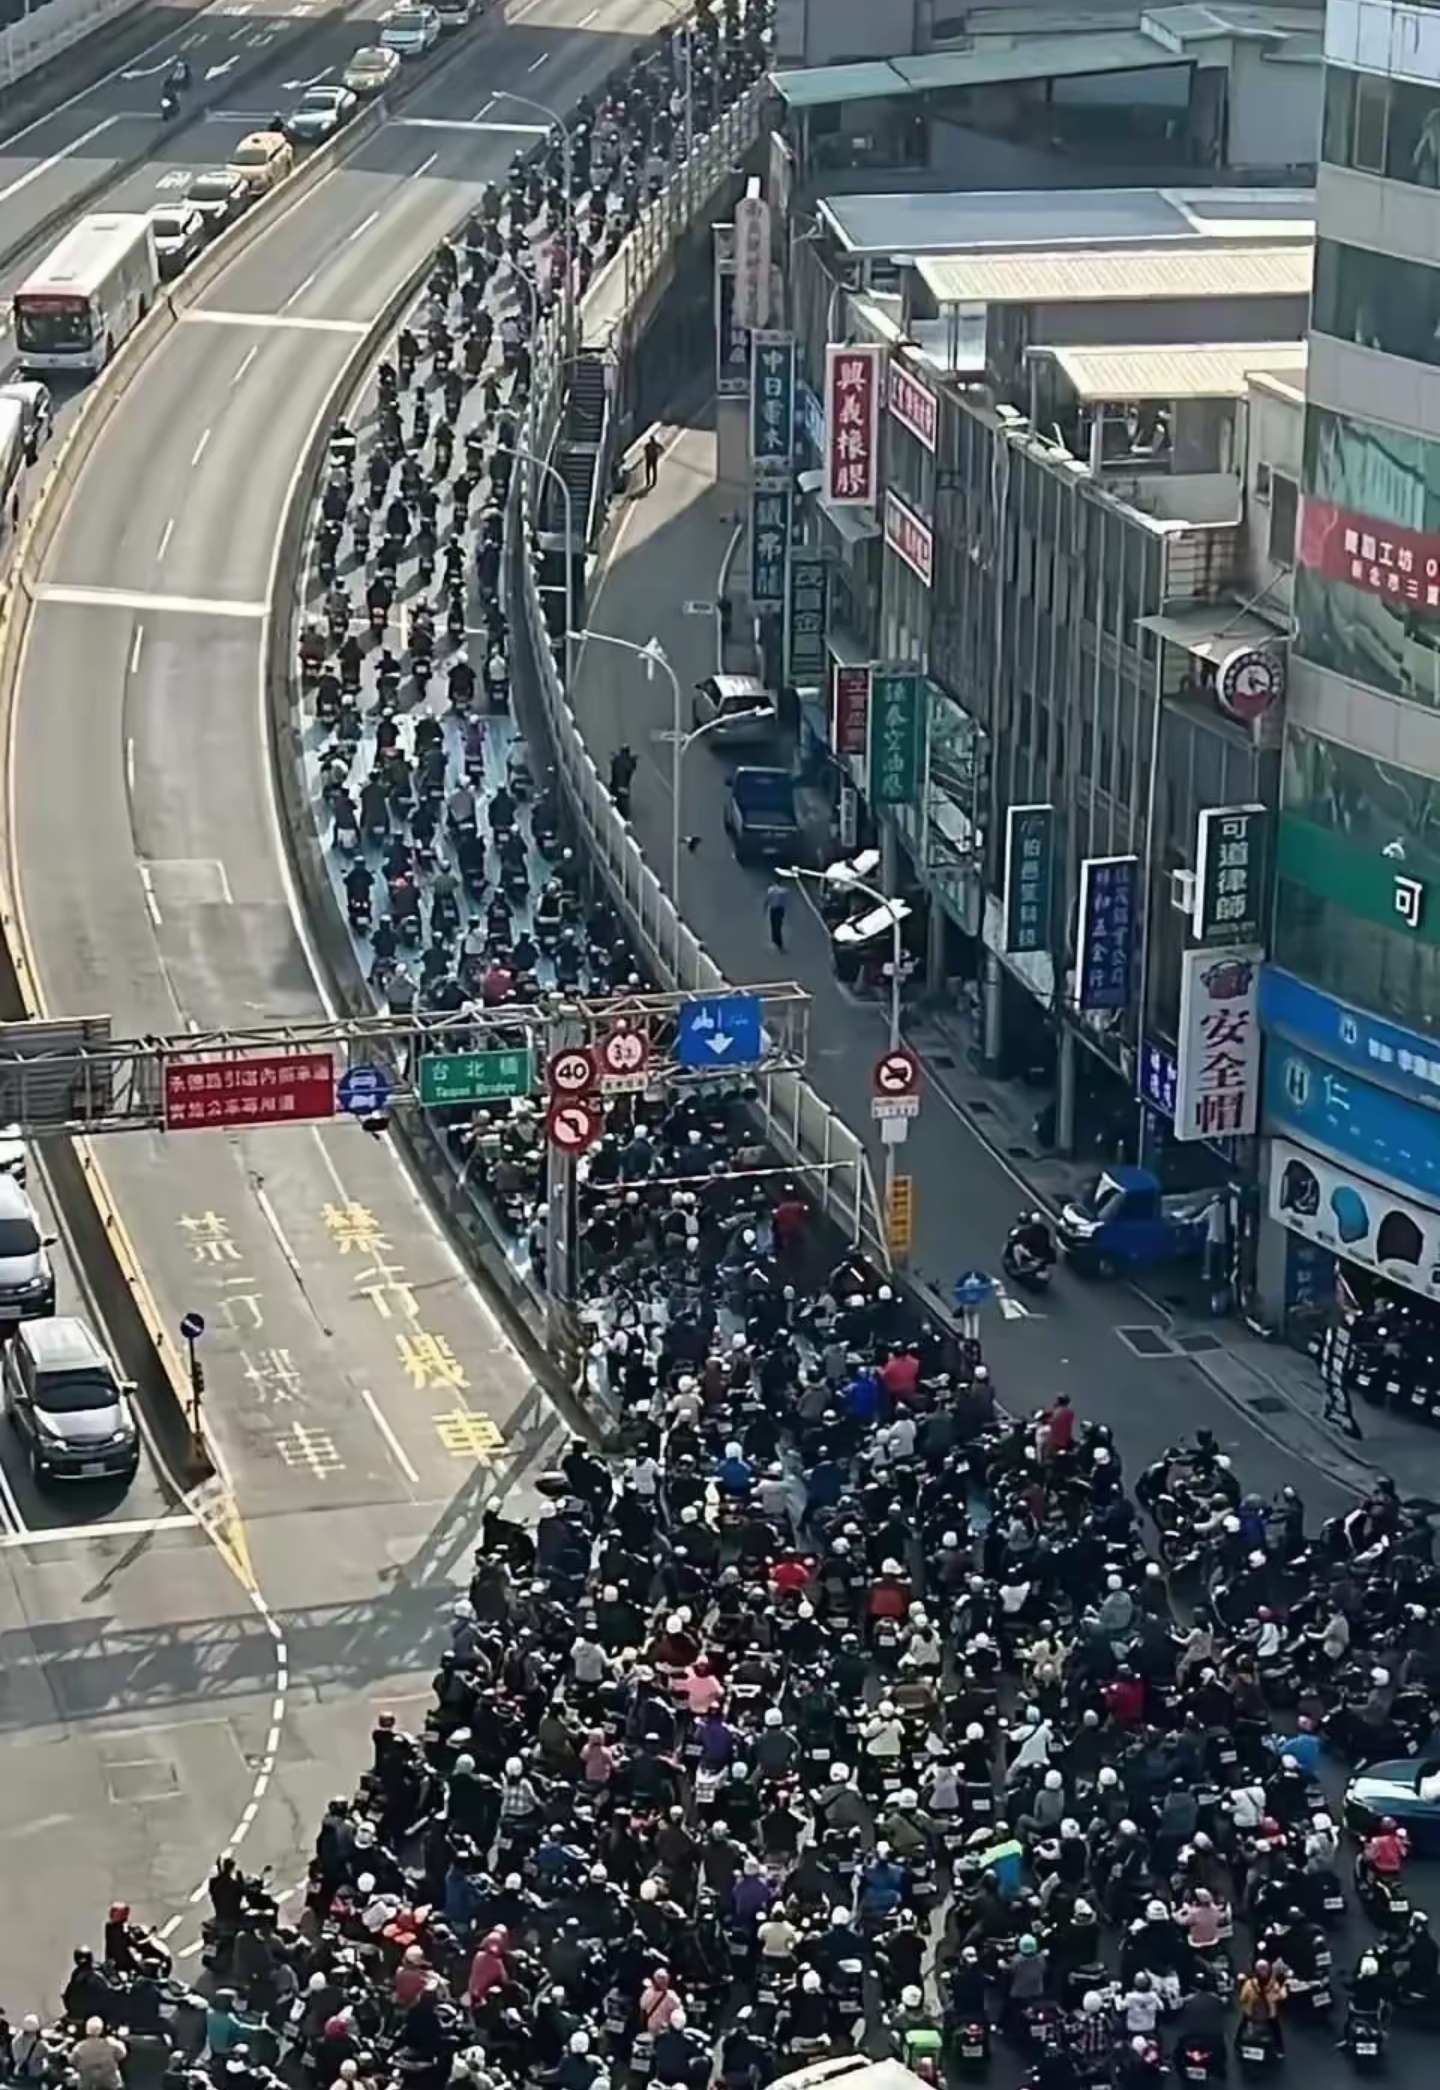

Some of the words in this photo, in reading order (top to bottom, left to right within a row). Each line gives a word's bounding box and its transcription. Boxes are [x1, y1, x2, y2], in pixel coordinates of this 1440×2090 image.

[835, 361, 867, 494] 興義橡膠
[1215, 816, 1250, 920] 可道律師
[1394, 875, 1422, 927] 可
[557, 1062, 587, 1080] 40
[1195, 1008, 1250, 1134] 安全帽
